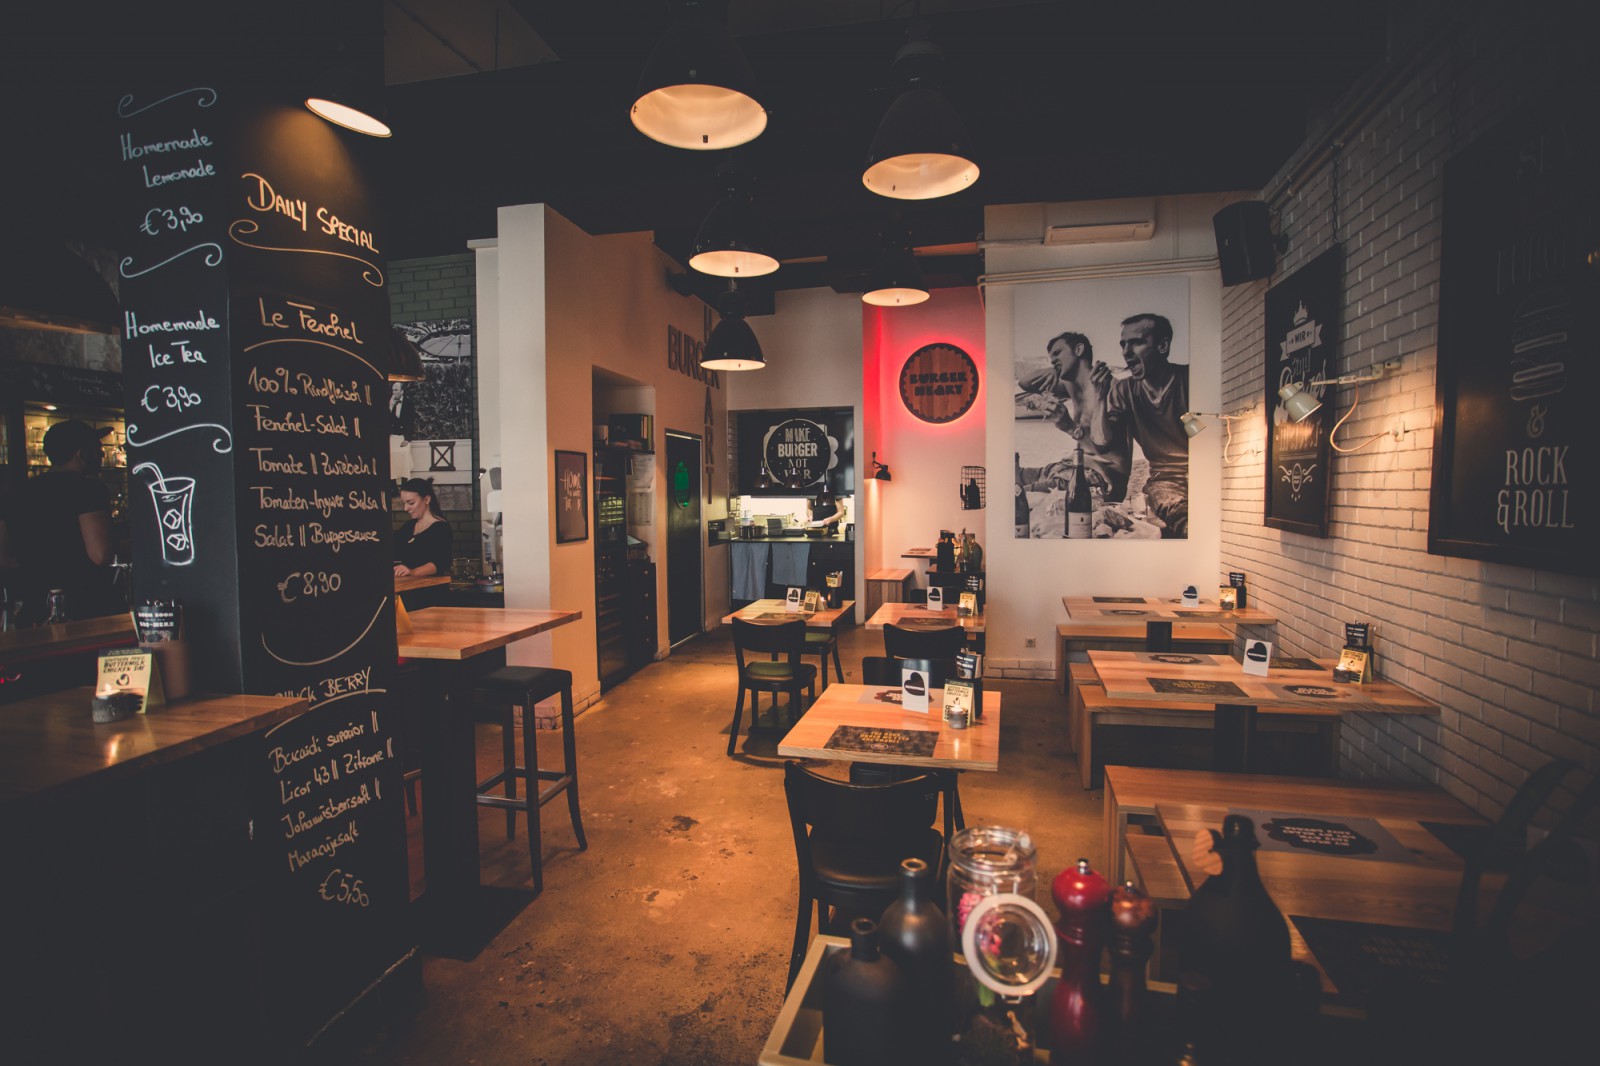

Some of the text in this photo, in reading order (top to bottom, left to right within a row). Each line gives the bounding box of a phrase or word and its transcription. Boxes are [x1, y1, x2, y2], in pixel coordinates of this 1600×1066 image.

[120, 128, 213, 161] Homemade
[142, 159, 216, 188] Lemonade
[241, 173, 380, 255] DAILY SPECIAL
[125, 309, 221, 340] Homemade
[258, 297, 364, 345] Le Fenchel
[148, 340, 208, 368] Ice Tea
[248, 366, 362, 405] 100% Rindfleisch
[909, 371, 967, 384] BURGER
[914, 385, 963, 396] HEART
[248, 447, 371, 476] Tomate Zwiebeln
[777, 442, 818, 458] BURGER
[1504, 445, 1569, 486] ROCK
[254, 523, 295, 548] Salat
[104, 660, 145, 668] BUTTERMILK
[318, 665, 371, 698] BERRY
[280, 749, 384, 805] Licor 43 Zitrone
